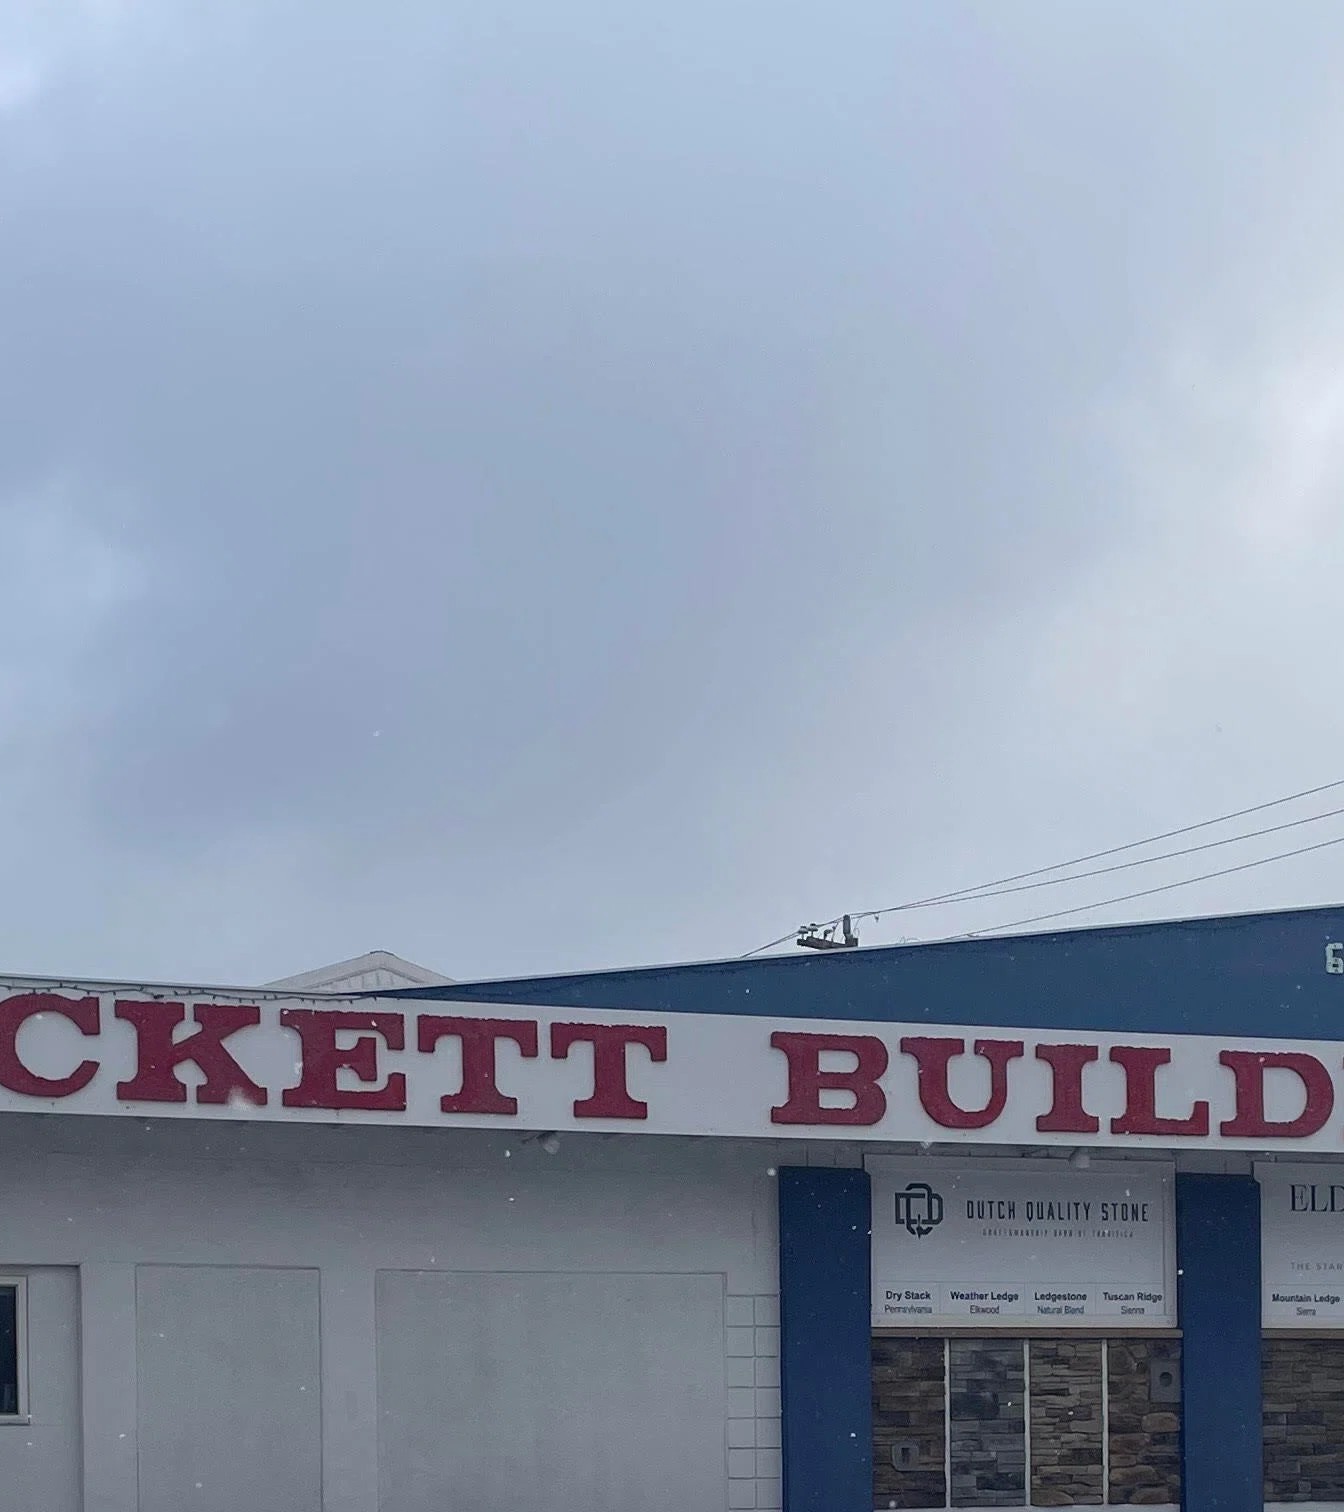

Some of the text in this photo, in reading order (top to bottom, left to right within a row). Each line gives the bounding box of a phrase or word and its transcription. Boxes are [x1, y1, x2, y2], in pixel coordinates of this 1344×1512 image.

[966, 1199, 1149, 1223] DUTCH QUALITY STONE
[885, 1290, 931, 1302] Dry Stack
[950, 1291, 1019, 1303] Weather Ledge
[1034, 1291, 1088, 1303] Ledgestone
[1102, 1291, 1163, 1304] Tuscan Ridge
[1271, 1293, 1341, 1305] Mountain Ledge
